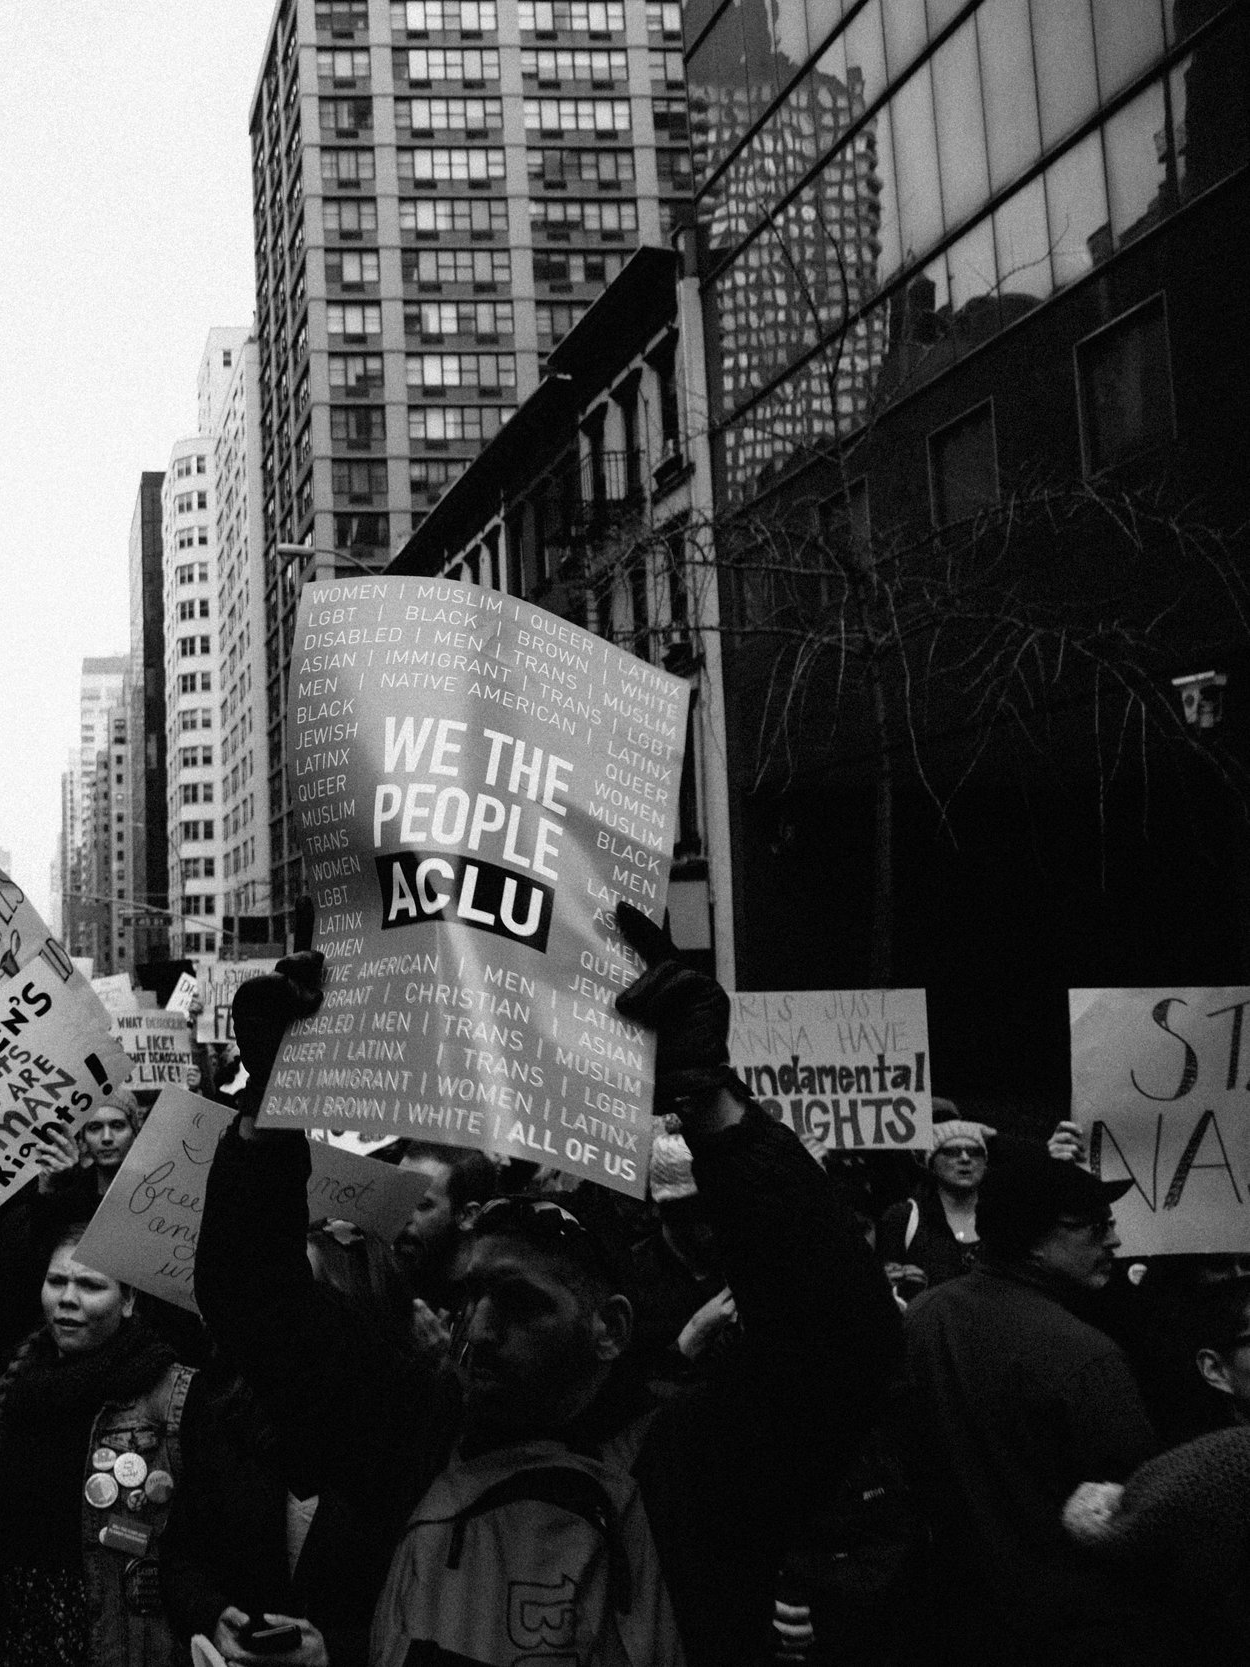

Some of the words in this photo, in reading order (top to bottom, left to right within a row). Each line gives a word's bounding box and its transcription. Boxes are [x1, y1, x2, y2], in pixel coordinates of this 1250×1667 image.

[308, 607, 358, 627] LGBT
[405, 605, 478, 629] BLACK
[518, 630, 588, 673] BROWN
[621, 680, 677, 719] WHITE
[312, 584, 388, 604] WOMEN
[417, 586, 502, 614] MUSLIM
[531, 614, 594, 655] QUEER
[619, 658, 680, 699] LATINX
[300, 652, 357, 675] ASIAN
[385, 650, 511, 683] IMMIGRANT
[540, 683, 602, 724] TRANS
[628, 727, 675, 760] LGBT
[304, 627, 402, 650] DISABLED
[434, 630, 483, 652] MEN
[513, 650, 577, 690] TRANS
[603, 692, 676, 736] MUSLIM
[297, 698, 354, 724] BLACK
[298, 677, 337, 698] MEN
[380, 673, 457, 692] NATIVE
[468, 682, 576, 735] AMERICAN
[608, 741, 671, 784] LATINX
[295, 722, 358, 750] JEWISH
[296, 748, 349, 776] LATINX
[384, 716, 467, 776] WE
[483, 728, 574, 816] THE
[605, 763, 668, 806] QUEER
[298, 774, 347, 801] QUEER
[594, 780, 665, 828] WOMEN
[301, 799, 355, 828] MUSLIM
[374, 783, 563, 881] PEOPLE
[588, 801, 662, 850] MUSLIM
[306, 830, 349, 856] TRANS
[597, 832, 660, 875] BLACK
[311, 855, 361, 881] WOMEN
[612, 865, 656, 899] MEN
[317, 885, 348, 908] LGBT
[388, 858, 543, 936] ACLU
[319, 911, 362, 935] LATINX
[316, 937, 364, 959] WOMEN
[580, 950, 640, 988] QUEE
[605, 937, 648, 971] MEN
[357, 953, 439, 980] AMERICAN
[483, 964, 535, 998] MEN
[573, 1001, 645, 1046] LATINX
[568, 974, 617, 1009] JEWI
[135, 1035, 175, 1051] LIKE!
[405, 982, 530, 1024] CHRISTIAN
[578, 1032, 643, 1071] ASIAN
[1130, 997, 1250, 1101] ST
[7, 1054, 55, 1101] ARE
[140, 1065, 182, 1083] LIKE!
[291, 1013, 354, 1036] DISABLED
[371, 1011, 411, 1032] MEN
[443, 1013, 523, 1051] TRANS
[555, 1047, 642, 1097] MUSLIM
[282, 1042, 326, 1062] QUEER
[347, 1039, 407, 1062] LATINX
[464, 1048, 544, 1087] TRANS
[584, 1086, 640, 1124] LGBT
[274, 1070, 304, 1088] MEN
[316, 1068, 412, 1092] IMMIGRANT
[438, 1075, 533, 1115] WOMEN
[560, 1107, 638, 1153] LATINX
[266, 1096, 310, 1116] BLACK
[322, 1096, 386, 1121] BROWN
[408, 1102, 484, 1135] WHITE
[508, 1120, 558, 1155] ALL
[565, 1137, 598, 1166] OF
[604, 1151, 637, 1182] US
[1089, 1109, 1250, 1213] NA
